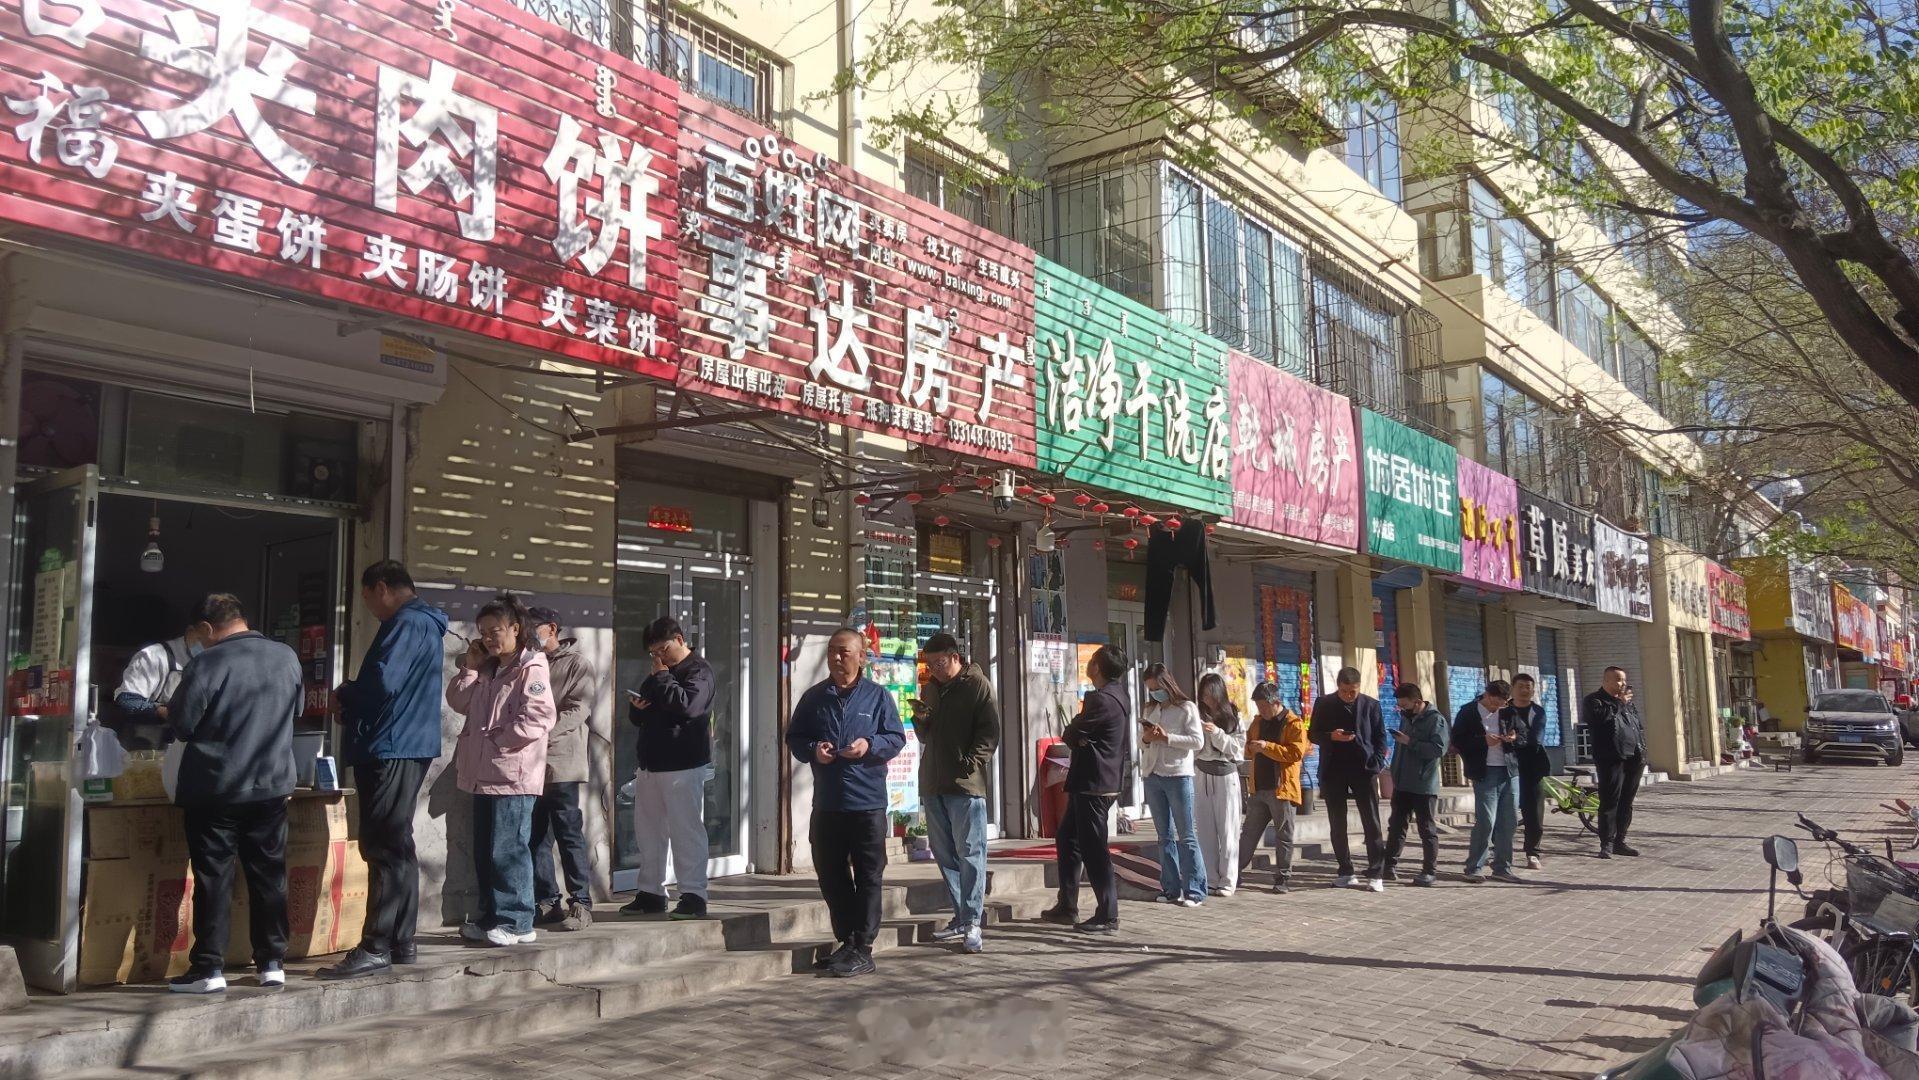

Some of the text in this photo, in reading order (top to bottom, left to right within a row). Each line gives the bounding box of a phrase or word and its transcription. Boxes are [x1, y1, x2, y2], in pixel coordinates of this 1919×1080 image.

[133, 0, 661, 290] 夹肉饼
[706, 143, 860, 260] 百姓网
[141, 170, 659, 356] 夹蛋饼 夹肠饼 夹菜饼
[700, 233, 1027, 423] 事达房产
[926, 235, 963, 266] 找工作
[978, 257, 1022, 289] 生活服务
[700, 356, 787, 399] 房屋出售出租
[803, 382, 854, 415] 房屋托管
[949, 420, 1013, 452] 13314848135
[1046, 328, 1229, 480] 洁净干洗店
[1367, 446, 1453, 517] 优居优住
